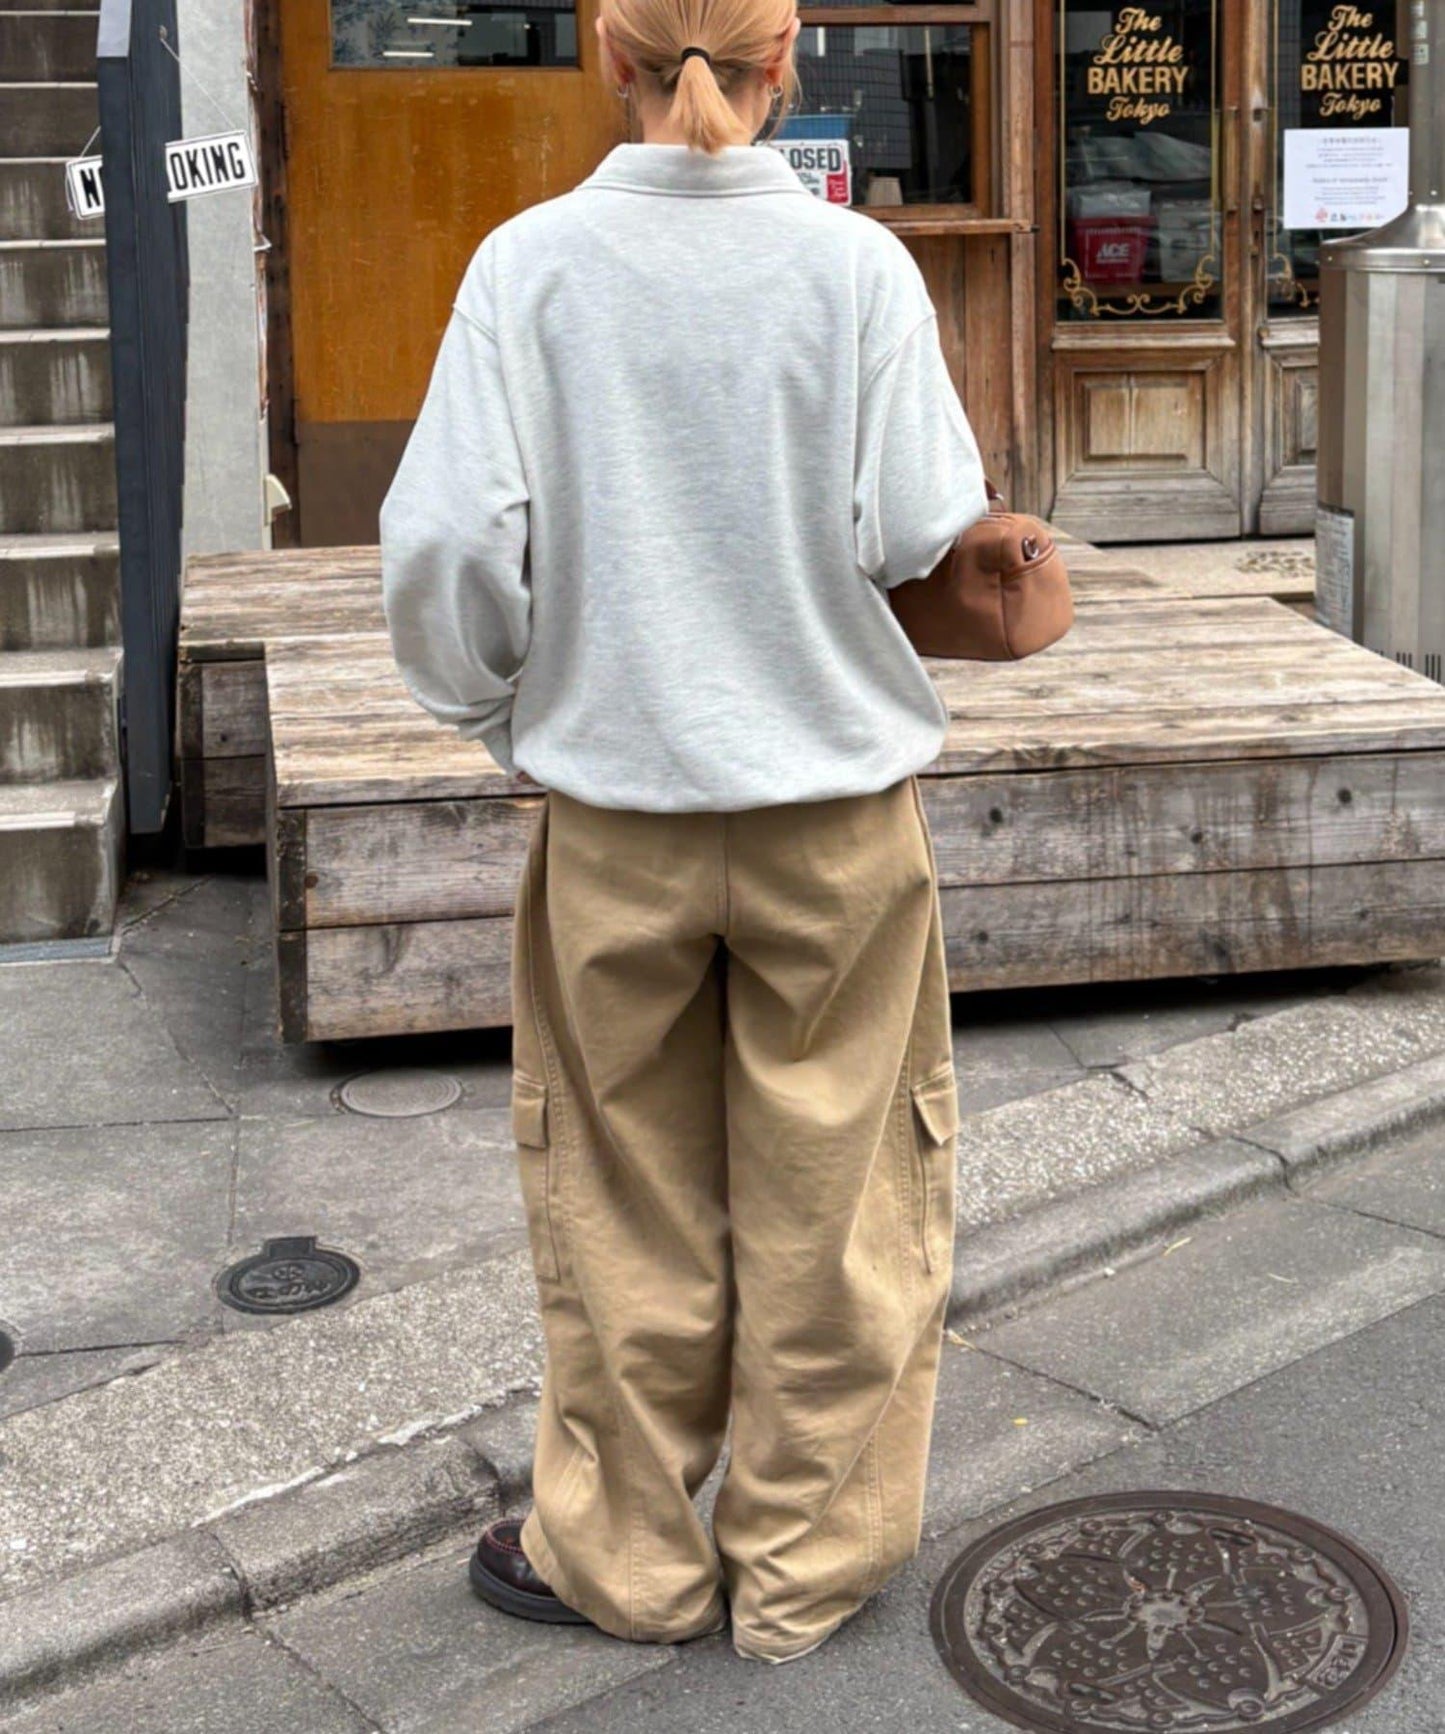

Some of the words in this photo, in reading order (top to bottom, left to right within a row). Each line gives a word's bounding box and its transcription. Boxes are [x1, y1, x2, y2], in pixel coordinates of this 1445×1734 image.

[1115, 7, 1162, 34] The
[1328, 4, 1373, 31] The
[1093, 34, 1184, 65] Little
[1307, 31, 1394, 60] Little
[1087, 66, 1189, 95] BAKERY
[1301, 62, 1399, 91] BAKERY
[1106, 95, 1170, 125] Tokyo
[1320, 92, 1381, 121] Tokyo
[780, 147, 841, 172] OSED
[79, 165, 103, 209] N
[169, 142, 246, 191] OKING
[1096, 243, 1130, 258] ACE
